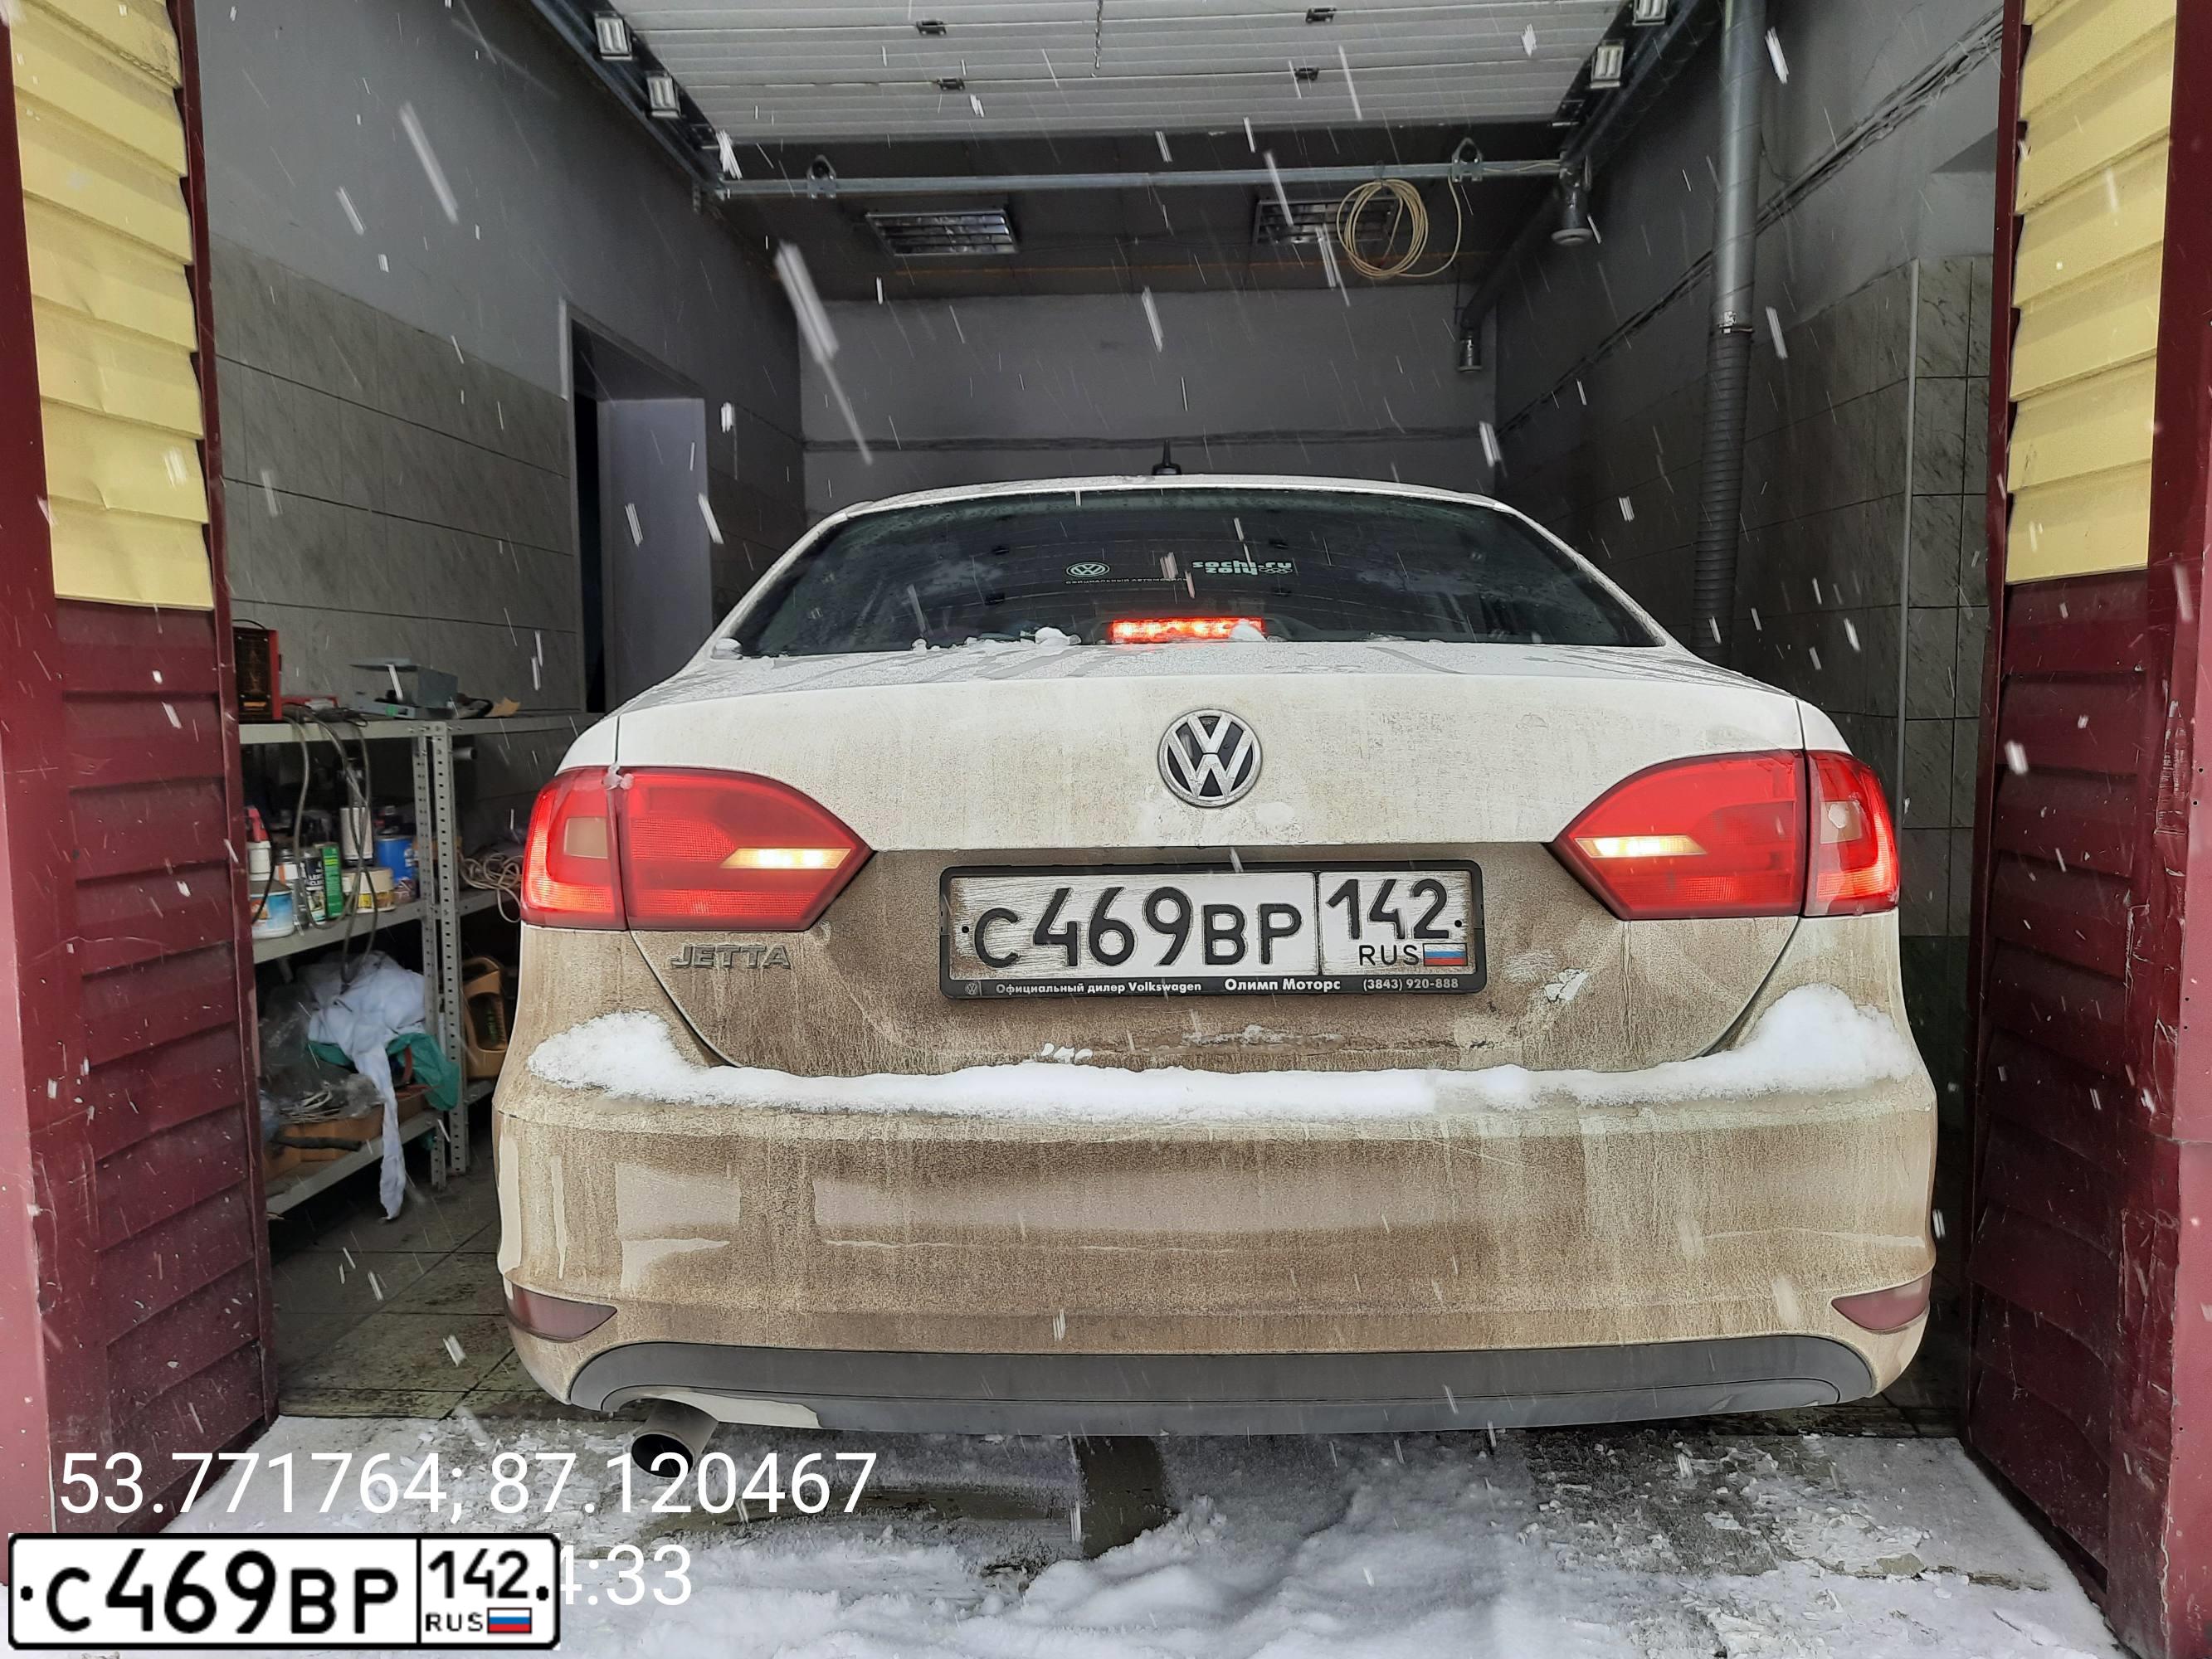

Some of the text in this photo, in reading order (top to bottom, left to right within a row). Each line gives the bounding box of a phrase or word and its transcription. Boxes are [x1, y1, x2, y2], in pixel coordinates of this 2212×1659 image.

[1326, 878, 1449, 940] 142
[670, 944, 792, 969] JETTA
[1358, 944, 1420, 966] RUS
[996, 981, 1202, 995] Официальный дилер Volkswagen
[1224, 977, 1342, 993] Олимп Моторс
[1362, 978, 1459, 991] (3843) 920-888
